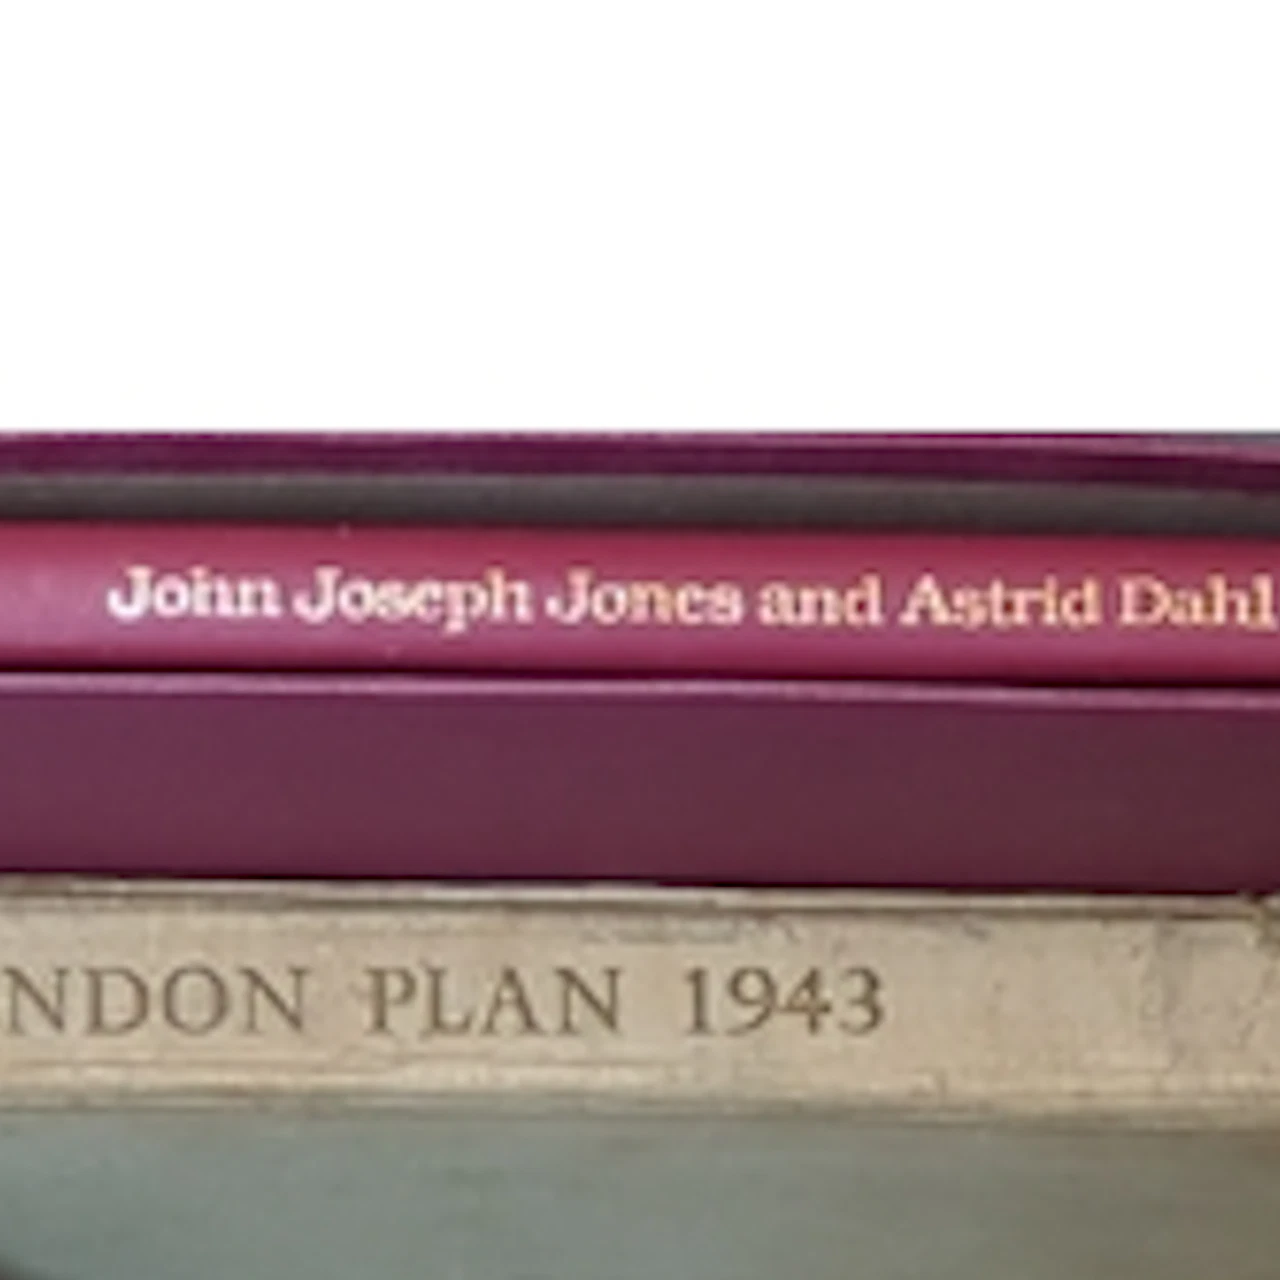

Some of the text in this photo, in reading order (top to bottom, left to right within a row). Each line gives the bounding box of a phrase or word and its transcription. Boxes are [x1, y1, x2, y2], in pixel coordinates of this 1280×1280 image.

[107, 563, 1279, 636] John Joseph Jones and Astrid Dahl
[364, 966, 624, 1037] PLAN
[681, 963, 887, 1040] 1943
